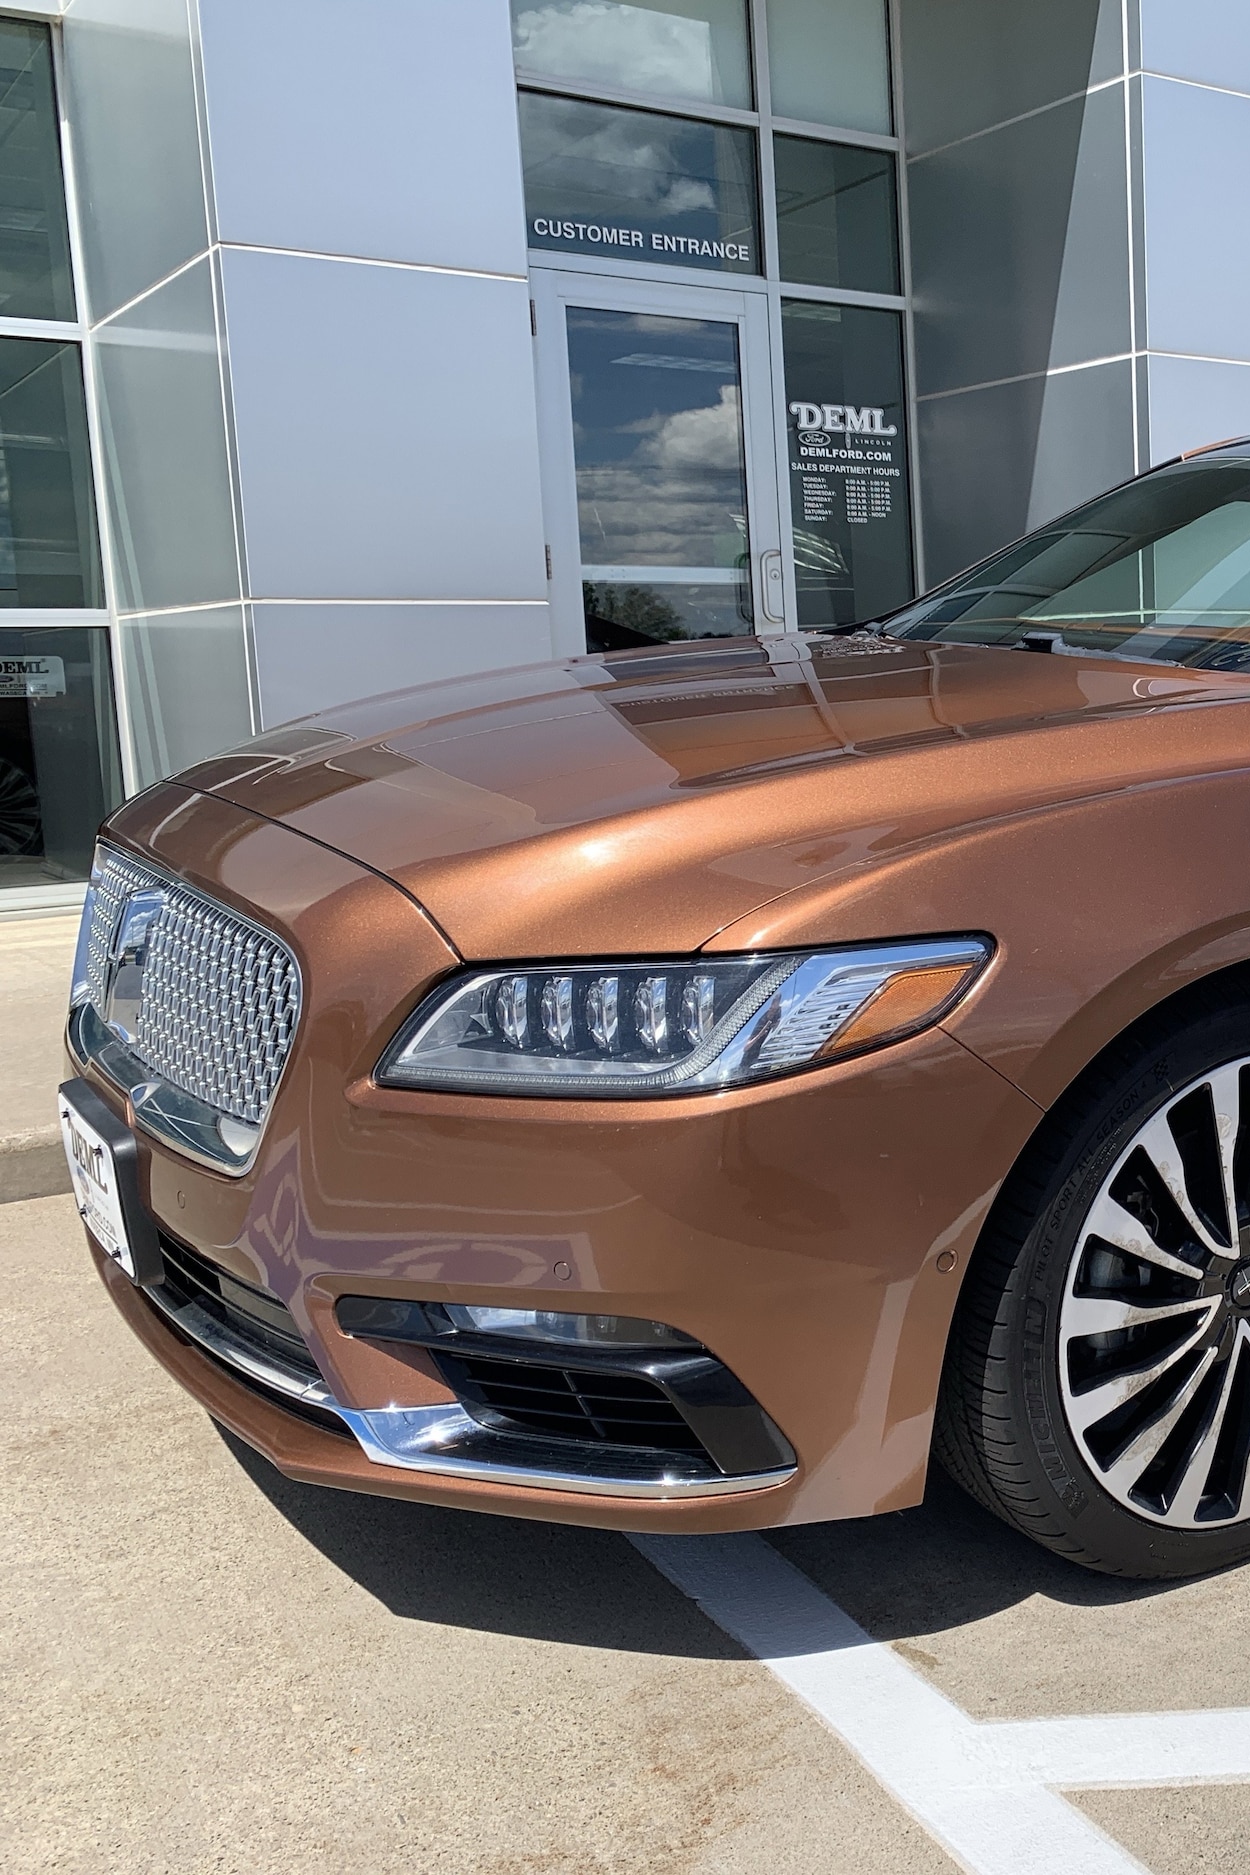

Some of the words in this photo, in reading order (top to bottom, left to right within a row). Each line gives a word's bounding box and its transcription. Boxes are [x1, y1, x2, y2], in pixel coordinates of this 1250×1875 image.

[534, 219, 644, 247] CUSTOMER
[652, 234, 750, 261] ENTRANCE
[789, 401, 898, 437] DEML
[791, 462, 818, 472] SALES
[819, 464, 871, 475] DEPARTMENT
[873, 467, 900, 477] HOURS
[800, 446, 892, 462] DEMLFORD.COM
[0, 661, 49, 673] EML
[1034, 1237, 1054, 1283] PILOT
[1050, 1180, 1077, 1232] SPORT
[1077, 1149, 1095, 1177] ALL
[1096, 1091, 1140, 1145] SEASON
[1023, 1308, 1068, 1482] MICHELIN
